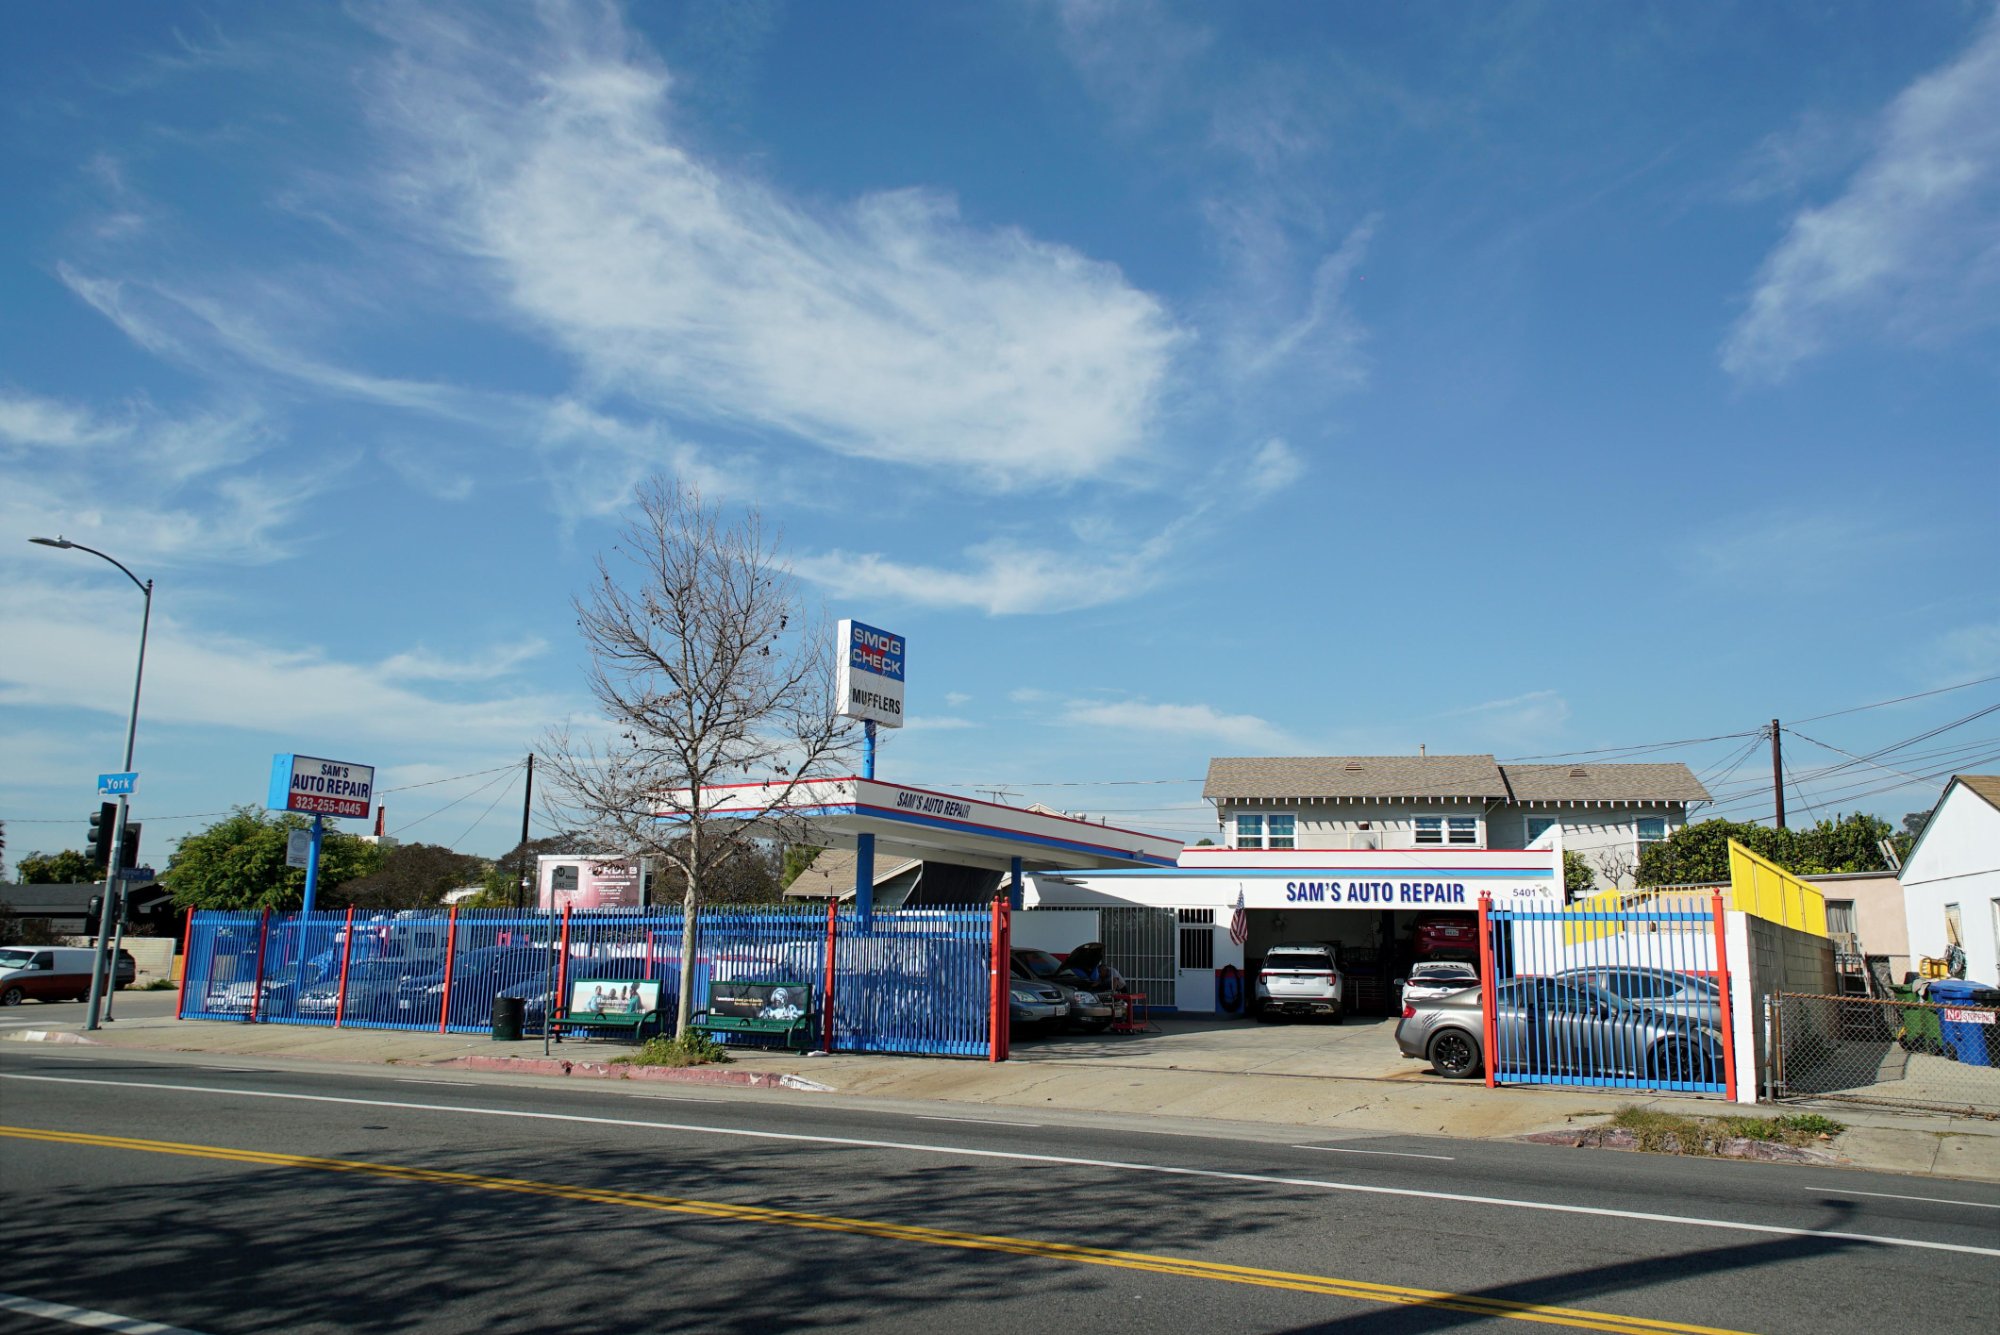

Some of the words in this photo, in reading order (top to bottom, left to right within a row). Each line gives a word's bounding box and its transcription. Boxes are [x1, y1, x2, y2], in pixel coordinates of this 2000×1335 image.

[854, 628, 901, 655] SMOG
[853, 648, 901, 674] CHECK
[852, 688, 900, 714] MUFFLERS
[321, 763, 349, 778] SAM'S
[107, 778, 130, 790] York
[291, 773, 325, 793] AUTO
[326, 778, 370, 798] REPAIR
[295, 796, 361, 815] 323-255-0445
[897, 791, 924, 810] SAM'S
[922, 797, 944, 814] AUTO
[943, 801, 971, 819] REPAIR
[1286, 882, 1342, 902] SAM'S
[1347, 882, 1394, 902] AUTO
[1400, 883, 1466, 903] REPAIR
[1513, 888, 1536, 897] 5401
[1946, 1010, 1961, 1020] NO
